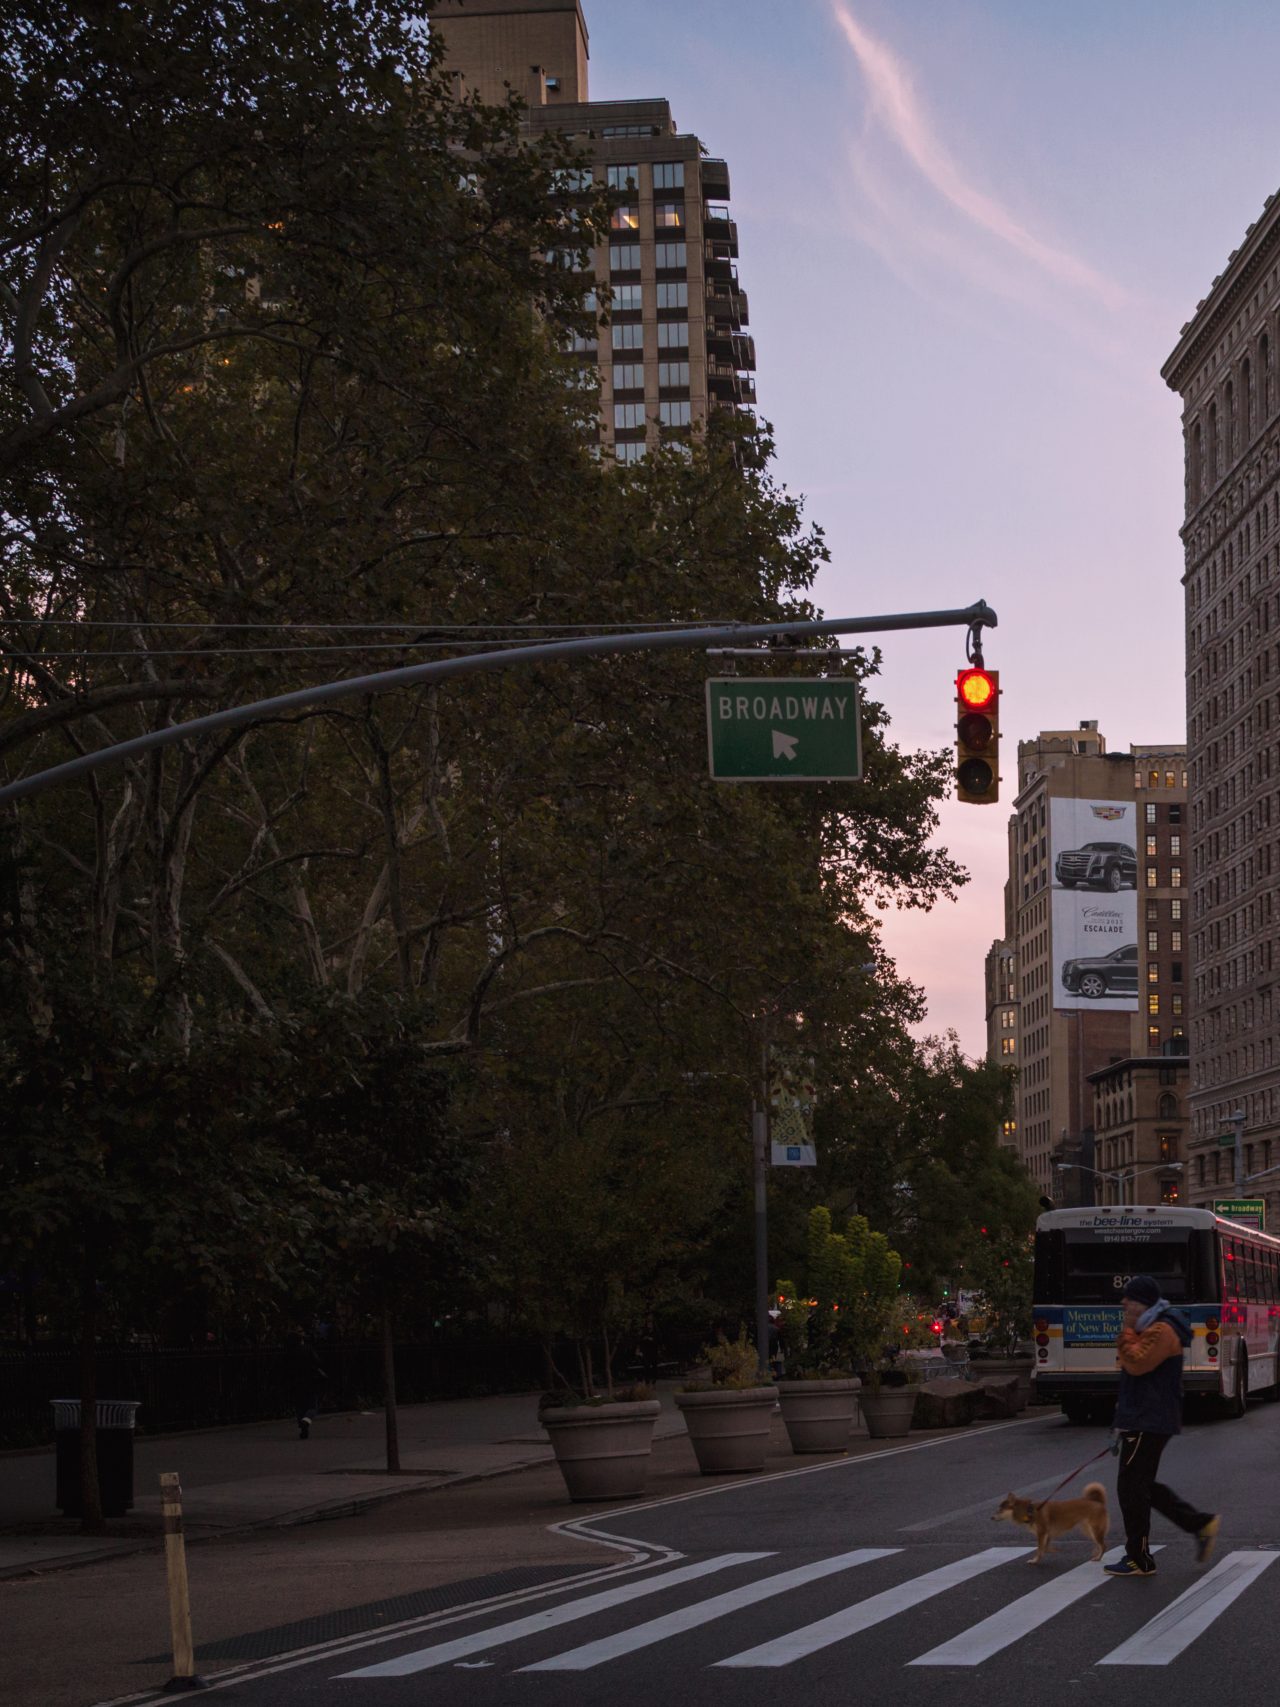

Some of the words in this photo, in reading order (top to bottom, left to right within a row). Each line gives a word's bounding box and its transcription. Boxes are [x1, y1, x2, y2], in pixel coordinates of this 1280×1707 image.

[719, 696, 848, 721] BROADWAY
[1084, 925, 1123, 933] ESCALADE
[1231, 1205, 1263, 1213] Broadway
[1094, 1216, 1142, 1226] bee-line
[1068, 1310, 1124, 1321] Mercedes-B
[1066, 1323, 1076, 1333] of
[1078, 1323, 1100, 1333] New
